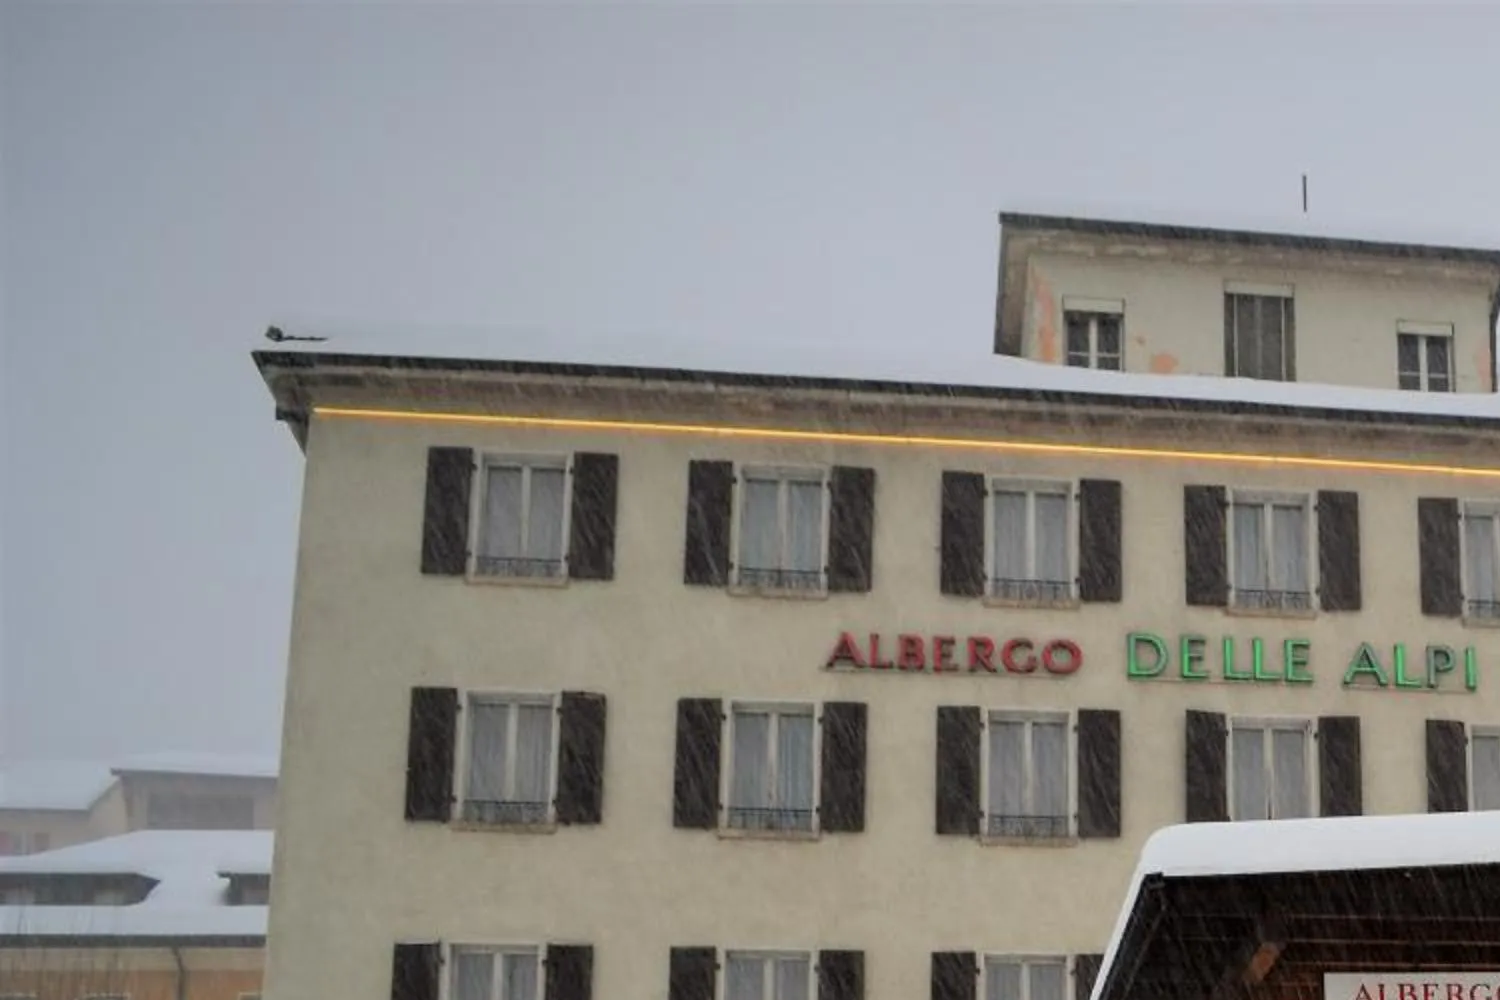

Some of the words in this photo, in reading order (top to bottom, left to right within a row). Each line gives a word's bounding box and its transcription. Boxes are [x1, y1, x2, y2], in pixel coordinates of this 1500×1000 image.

[825, 630, 1083, 675] ALBERGO
[1126, 631, 1315, 683] DELLE
[1342, 640, 1480, 691] ALPI
